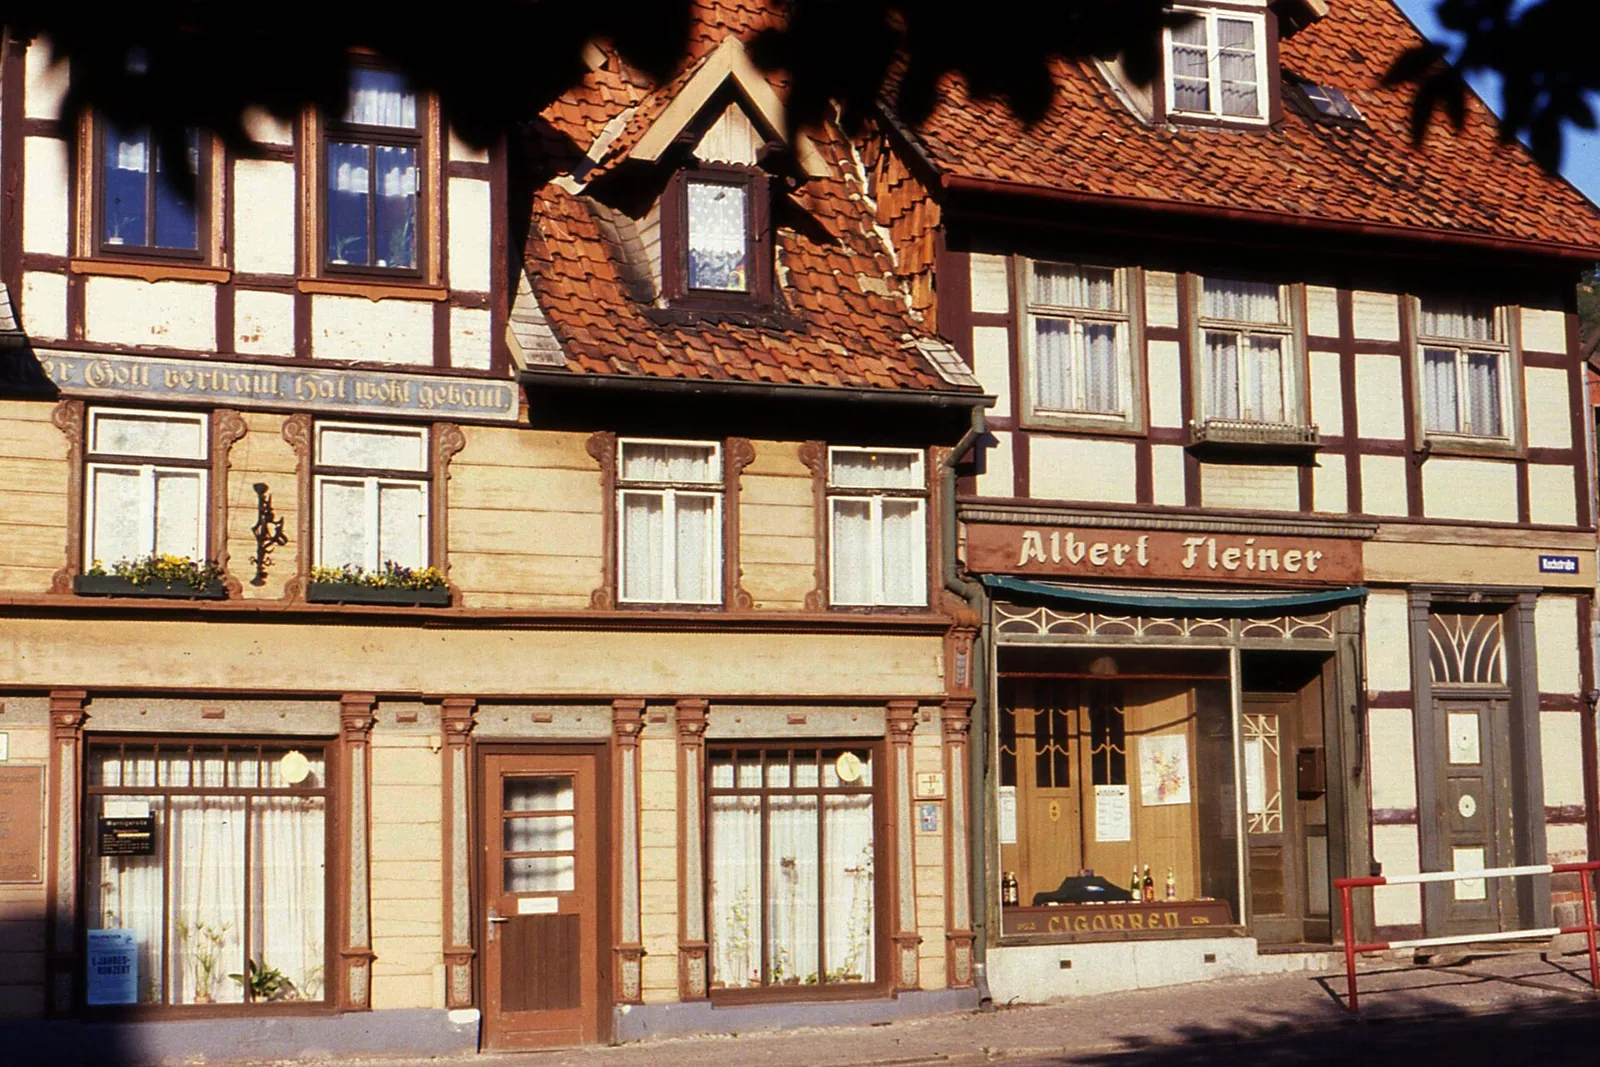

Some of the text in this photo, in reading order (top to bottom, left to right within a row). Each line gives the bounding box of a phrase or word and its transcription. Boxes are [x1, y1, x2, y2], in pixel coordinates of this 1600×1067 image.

[84, 358, 150, 388] Gott
[1017, 529, 1323, 573] Albert Fleiner
